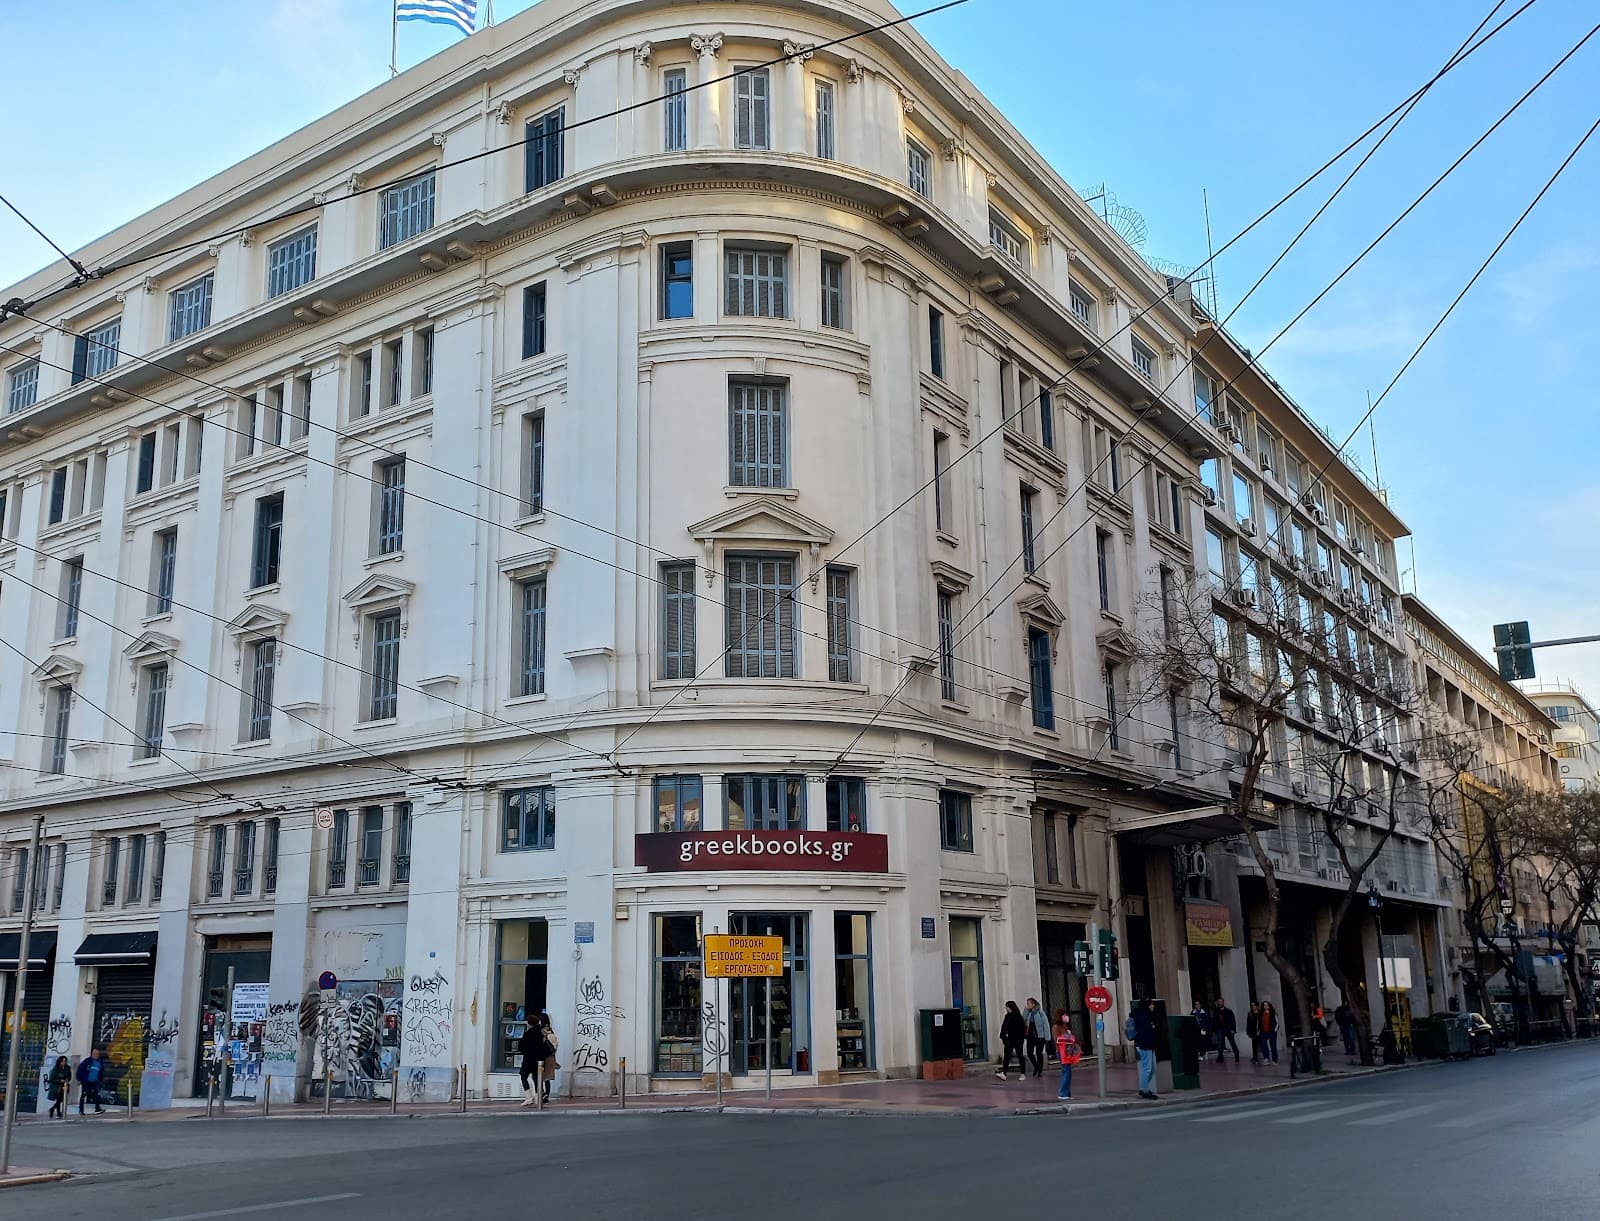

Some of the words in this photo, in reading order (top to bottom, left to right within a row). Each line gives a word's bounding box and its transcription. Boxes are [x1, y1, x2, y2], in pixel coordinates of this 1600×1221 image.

[680, 834, 853, 862] greekbooks.gr
[729, 938, 764, 948] ΠΡΟΣΟΧΗ
[710, 951, 744, 961] ΕΙΣΟΔΟΣ
[752, 951, 780, 961] ΕΞΟΔΟΣ
[724, 964, 768, 974] ΕΡΓΟΤΑΞΙΟΥ
